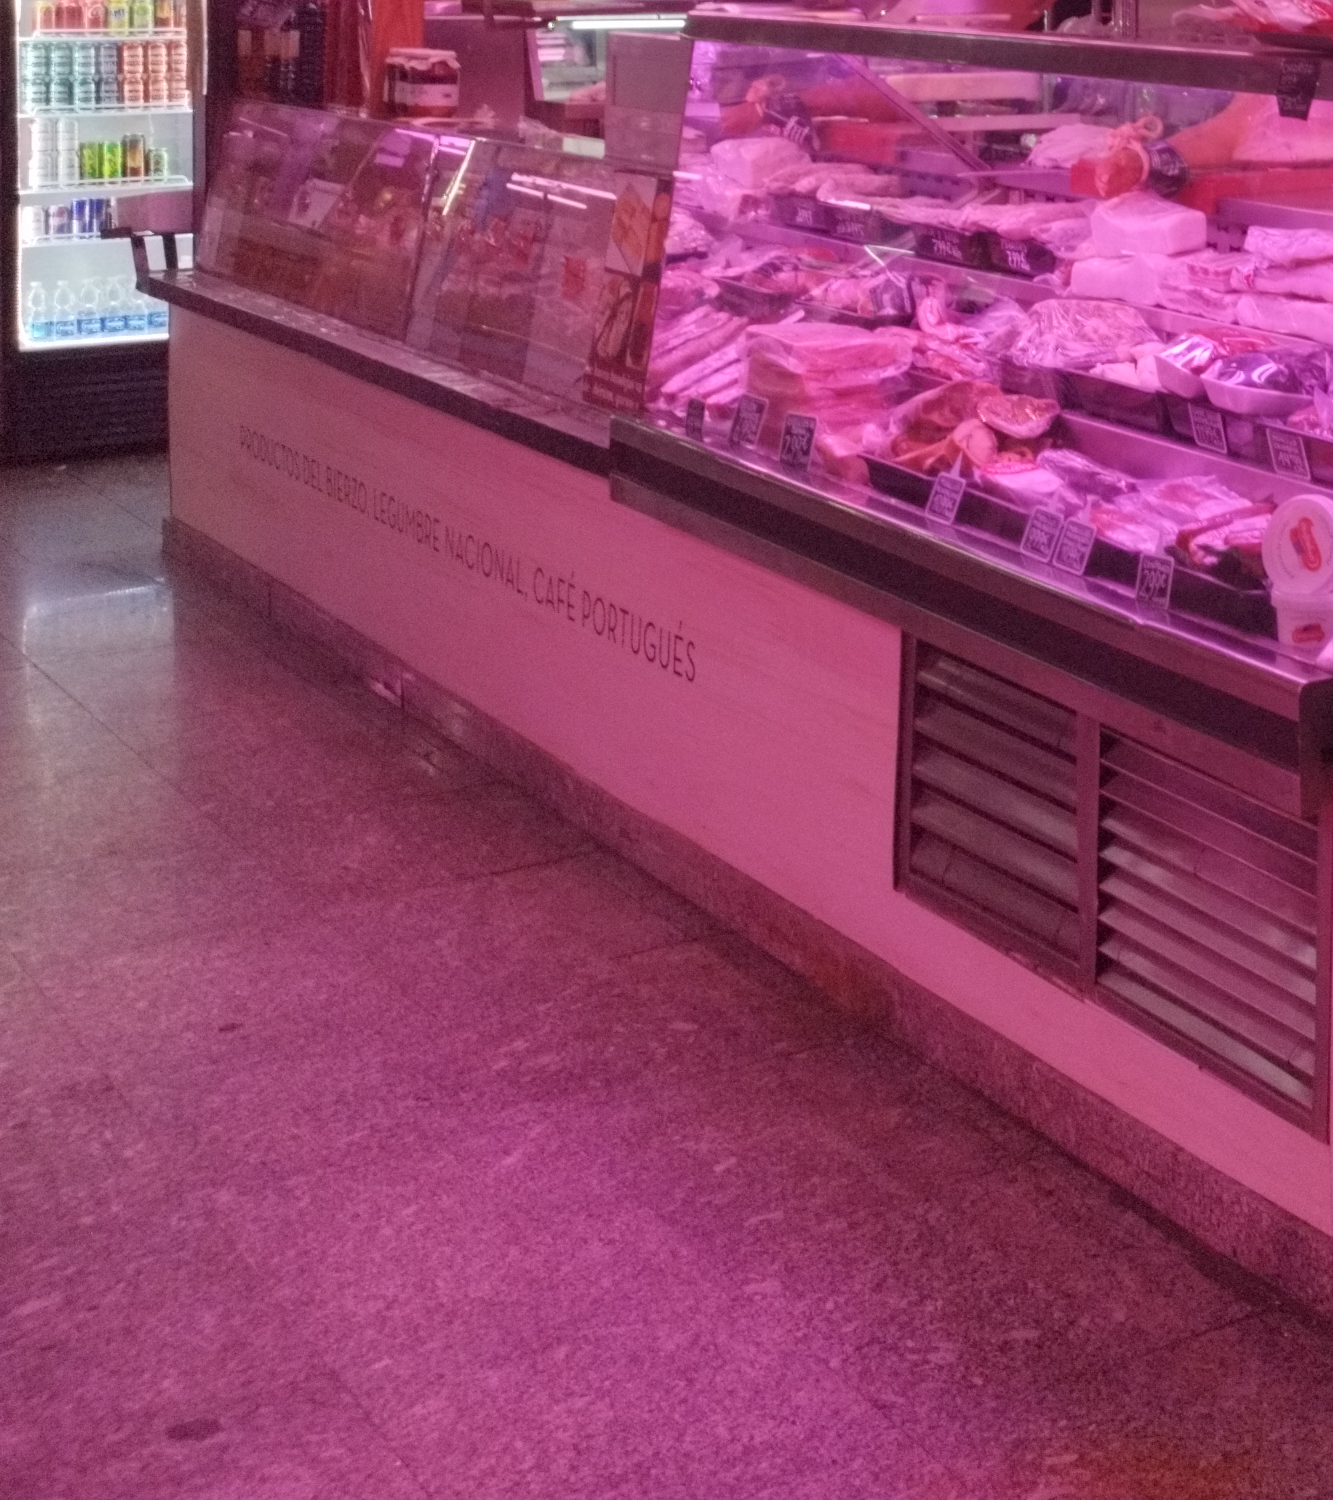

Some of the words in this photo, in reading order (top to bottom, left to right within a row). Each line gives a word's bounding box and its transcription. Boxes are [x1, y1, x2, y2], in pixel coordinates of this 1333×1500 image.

[239, 425, 301, 481] PRODUCTOS
[303, 453, 325, 491] DEL
[372, 486, 441, 551] LEGUMBRE
[532, 570, 577, 623] CAFÉ
[581, 595, 698, 684] PORTUGUÉS
